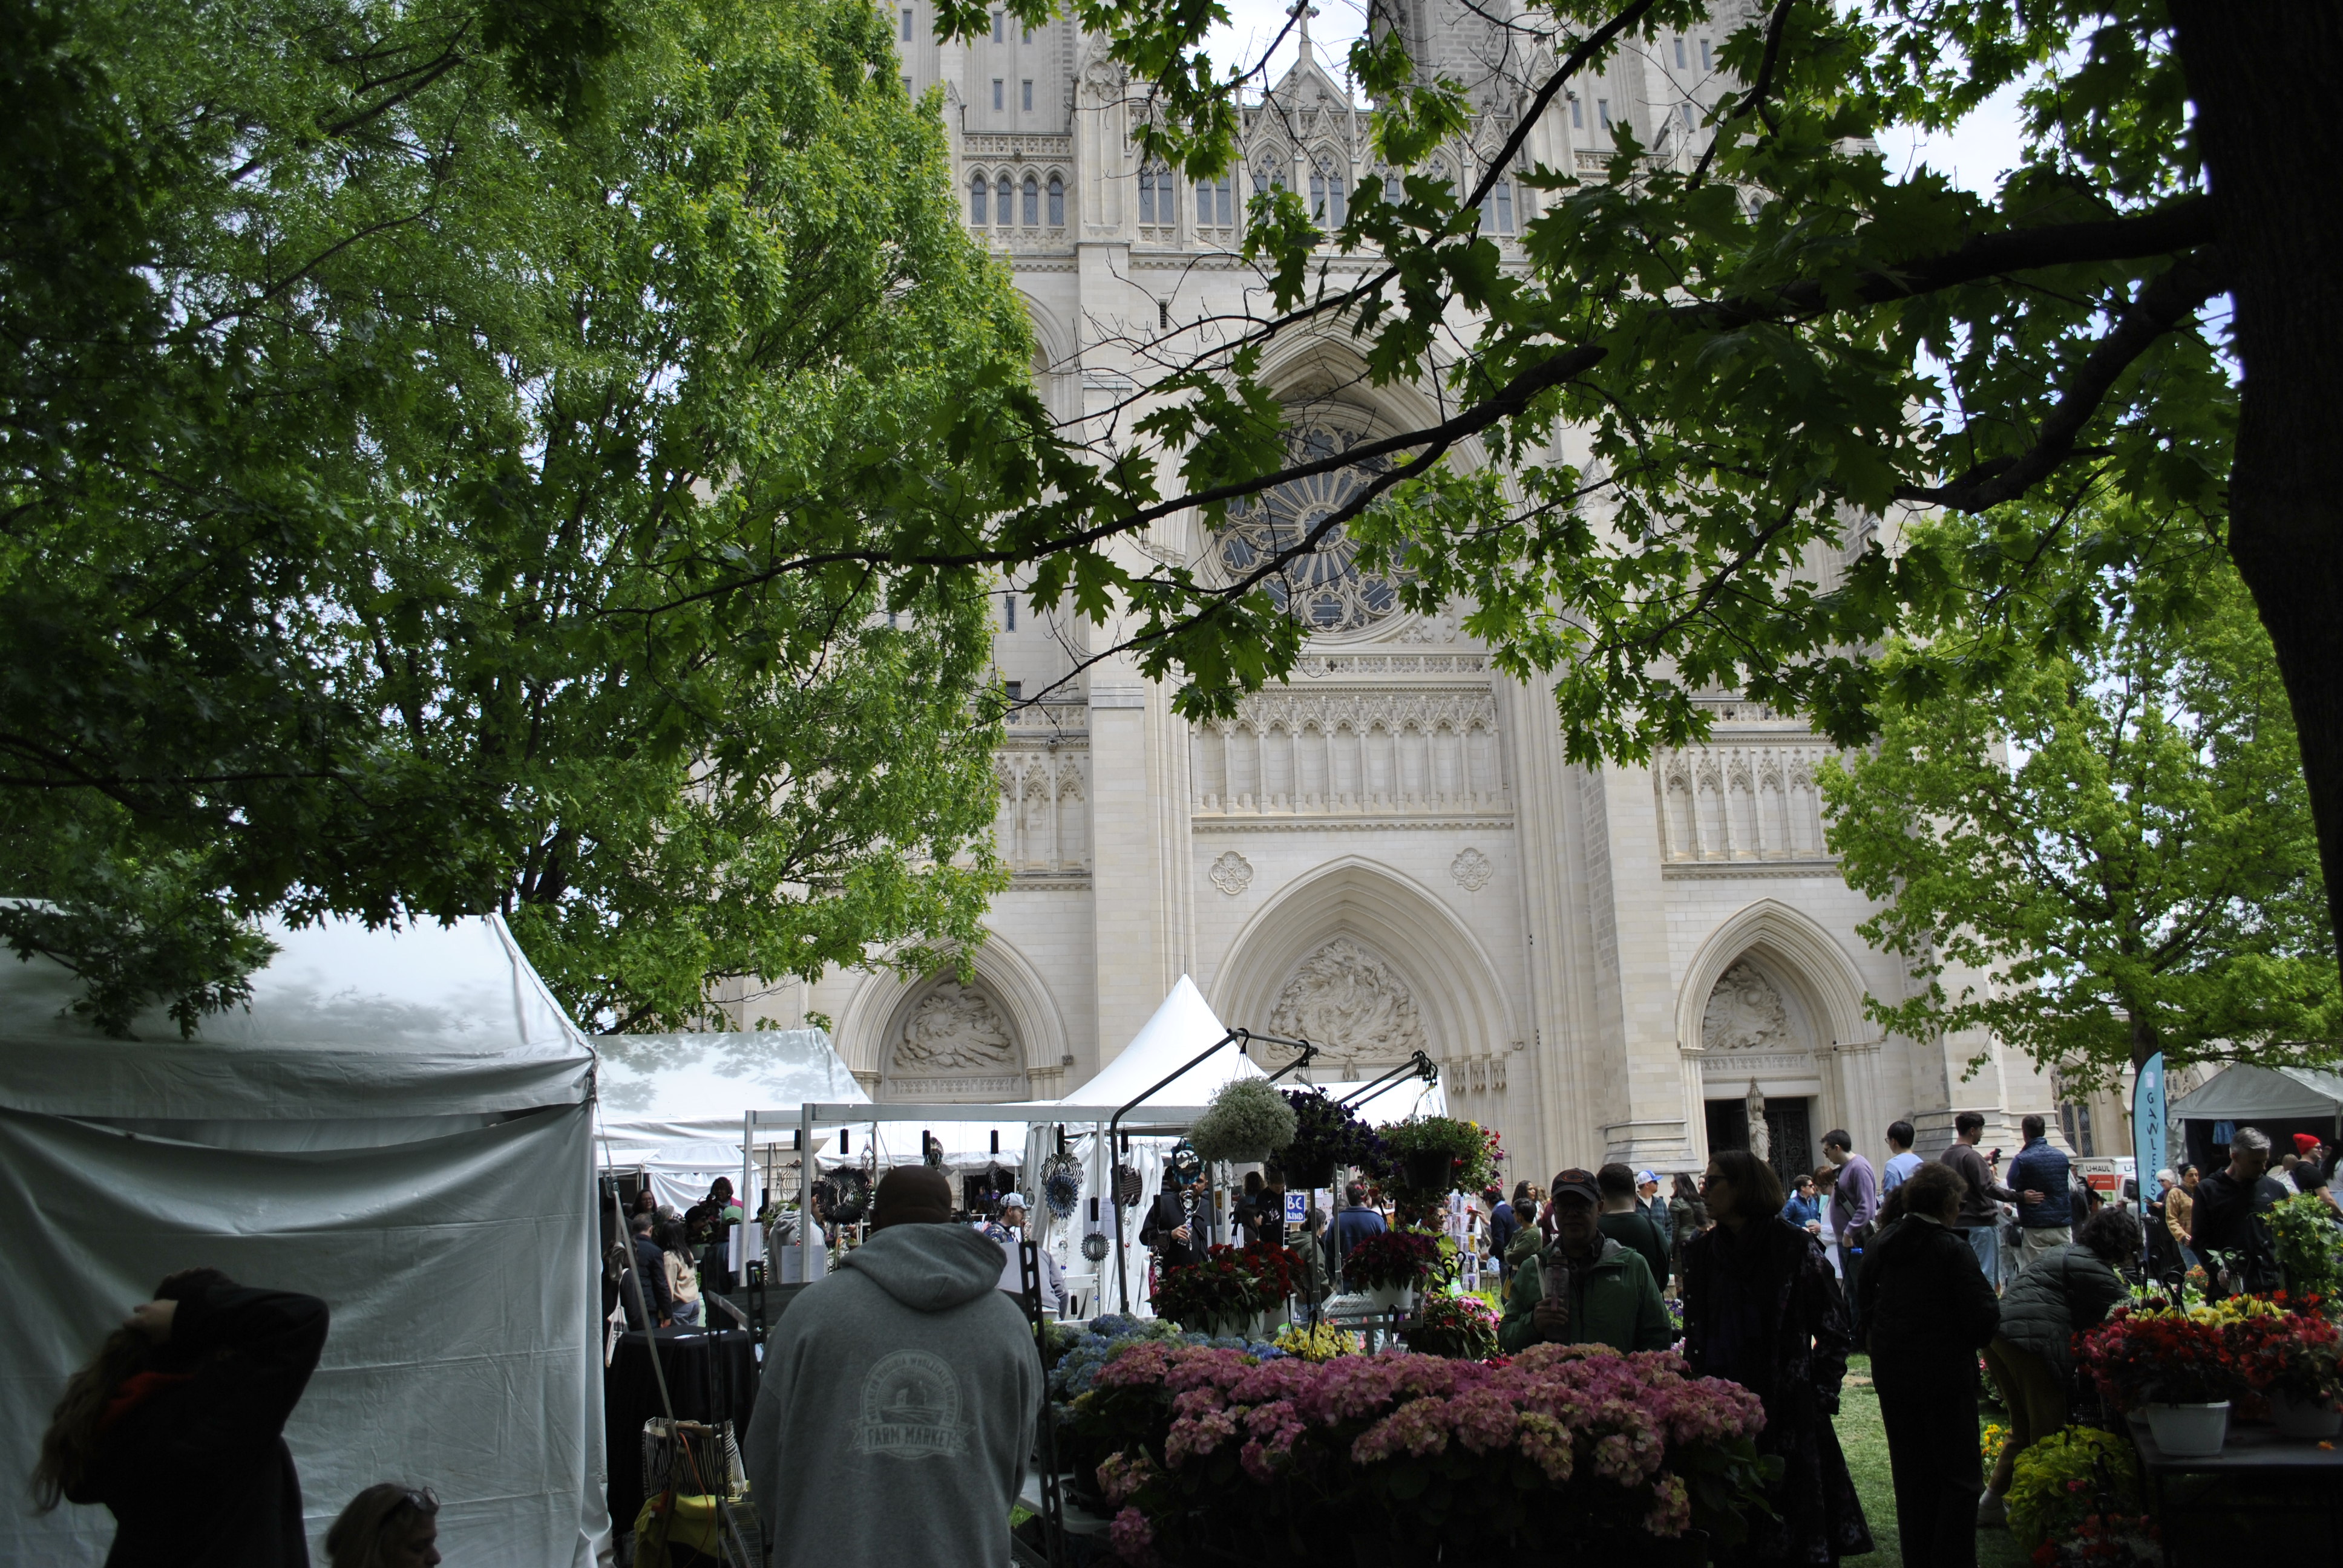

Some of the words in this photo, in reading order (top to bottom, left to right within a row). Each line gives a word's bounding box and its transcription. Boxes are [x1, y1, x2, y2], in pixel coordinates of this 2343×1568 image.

[2147, 1093, 2158, 1196] GAWLERS
[1287, 1195, 1303, 1210] BE
[1287, 1211, 1304, 1220] KIND
[910, 1357, 949, 1384] WHOLESALE
[944, 1384, 956, 1424] GROWERS
[868, 1426, 900, 1446] FARM
[905, 1425, 954, 1448] MARKET
